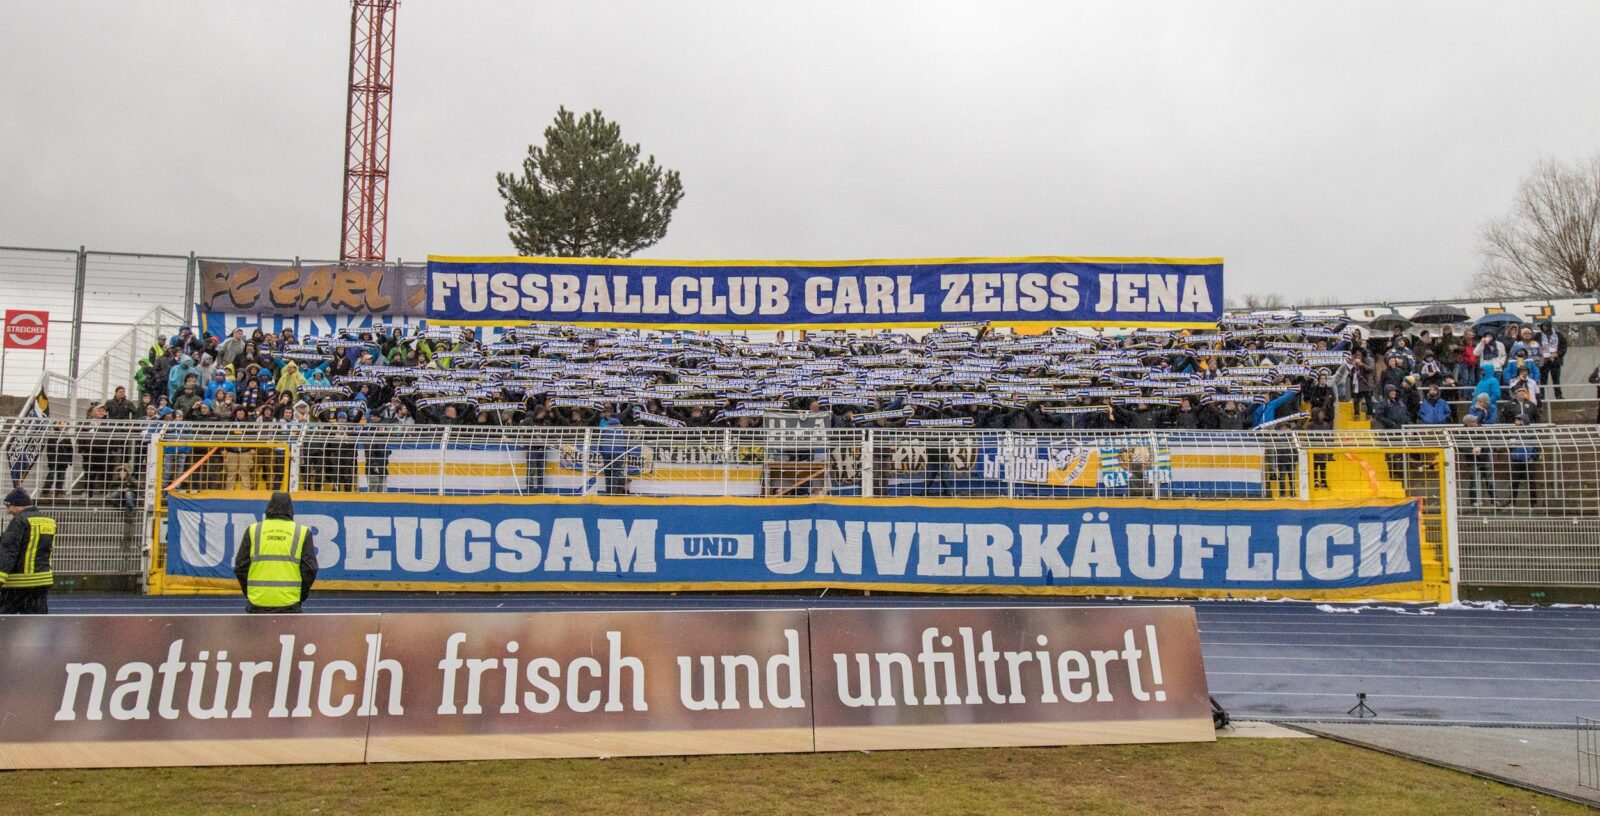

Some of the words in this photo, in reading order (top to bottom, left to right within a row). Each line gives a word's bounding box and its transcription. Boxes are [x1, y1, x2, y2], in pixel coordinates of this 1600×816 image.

[201, 264, 261, 312] FC
[269, 264, 391, 314] CARL
[432, 272, 791, 315] FUSSBALLCLUB
[804, 275, 925, 315] CARL
[940, 272, 1081, 313] ZEISS
[1095, 273, 1213, 313] JENA
[6, 325, 46, 335] STREICHER
[683, 536, 739, 557] UND
[762, 511, 1411, 581] UNVERKÄUFLICH
[53, 633, 404, 721] natürlich
[437, 630, 649, 715] frisch
[676, 628, 806, 711] und
[833, 624, 1167, 707] unfiltriert!
